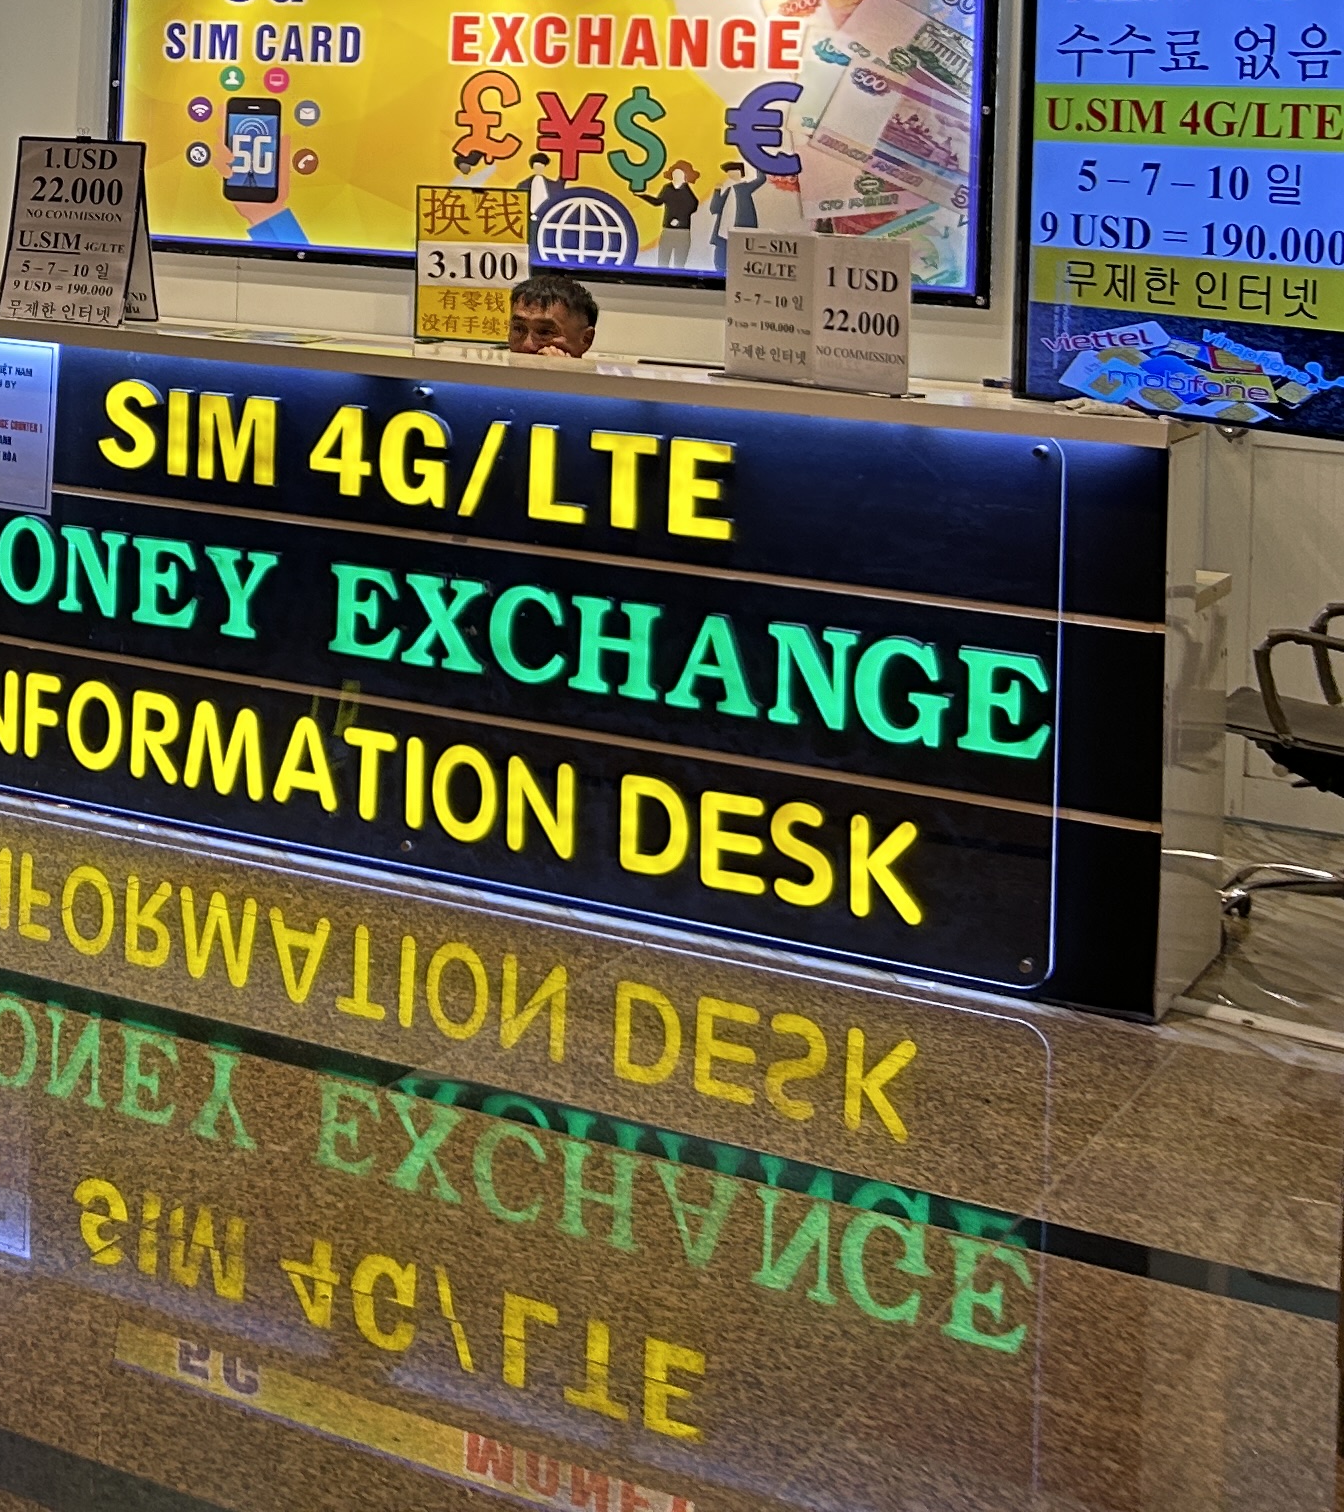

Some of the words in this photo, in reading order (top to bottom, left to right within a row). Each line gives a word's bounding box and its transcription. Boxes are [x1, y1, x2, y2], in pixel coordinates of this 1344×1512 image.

[165, 22, 239, 61] SIM
[255, 24, 362, 64] CARD
[449, 15, 804, 70] EXCHANGE
[1056, 24, 1209, 79] 수수료
[1234, 23, 1342, 81] 없음
[1046, 97, 1167, 135] U.SIM
[1179, 101, 1343, 141] 4G/LTE
[44, 147, 117, 170] 1.USD
[231, 135, 273, 174] 5G
[30, 176, 123, 206] 22.000
[1208, 166, 1249, 201] 10
[1267, 163, 1301, 206] 일
[26, 208, 43, 219] NO
[45, 209, 122, 223] COMMISSION
[423, 188, 524, 239] 换钱
[19, 230, 81, 251] U.SIM
[1040, 212, 1058, 243] 9
[1070, 213, 1151, 250] USD
[1201, 222, 1344, 266] 190.000
[427, 250, 518, 281] 3.100
[743, 261, 797, 278] 4G/LTE
[847, 267, 898, 292] USD
[24, 279, 52, 292] USD
[67, 283, 113, 297] 190.000
[1066, 260, 1180, 306] 무제한
[1195, 271, 1318, 320] 인터넷
[7, 299, 57, 319] 무제한
[61, 302, 110, 324] 인터넷
[422, 313, 509, 336] 没有手续
[823, 308, 900, 338] 22.000
[816, 345, 833, 356] NO
[833, 347, 905, 365] COMMISSION
[1041, 329, 1153, 352] viettel
[1202, 329, 1311, 384] vinaphone
[1108, 369, 1270, 402] mobifone
[98, 379, 278, 487] SIM
[328, 561, 1052, 763] EXCHANGE
[616, 772, 922, 926] DESK
